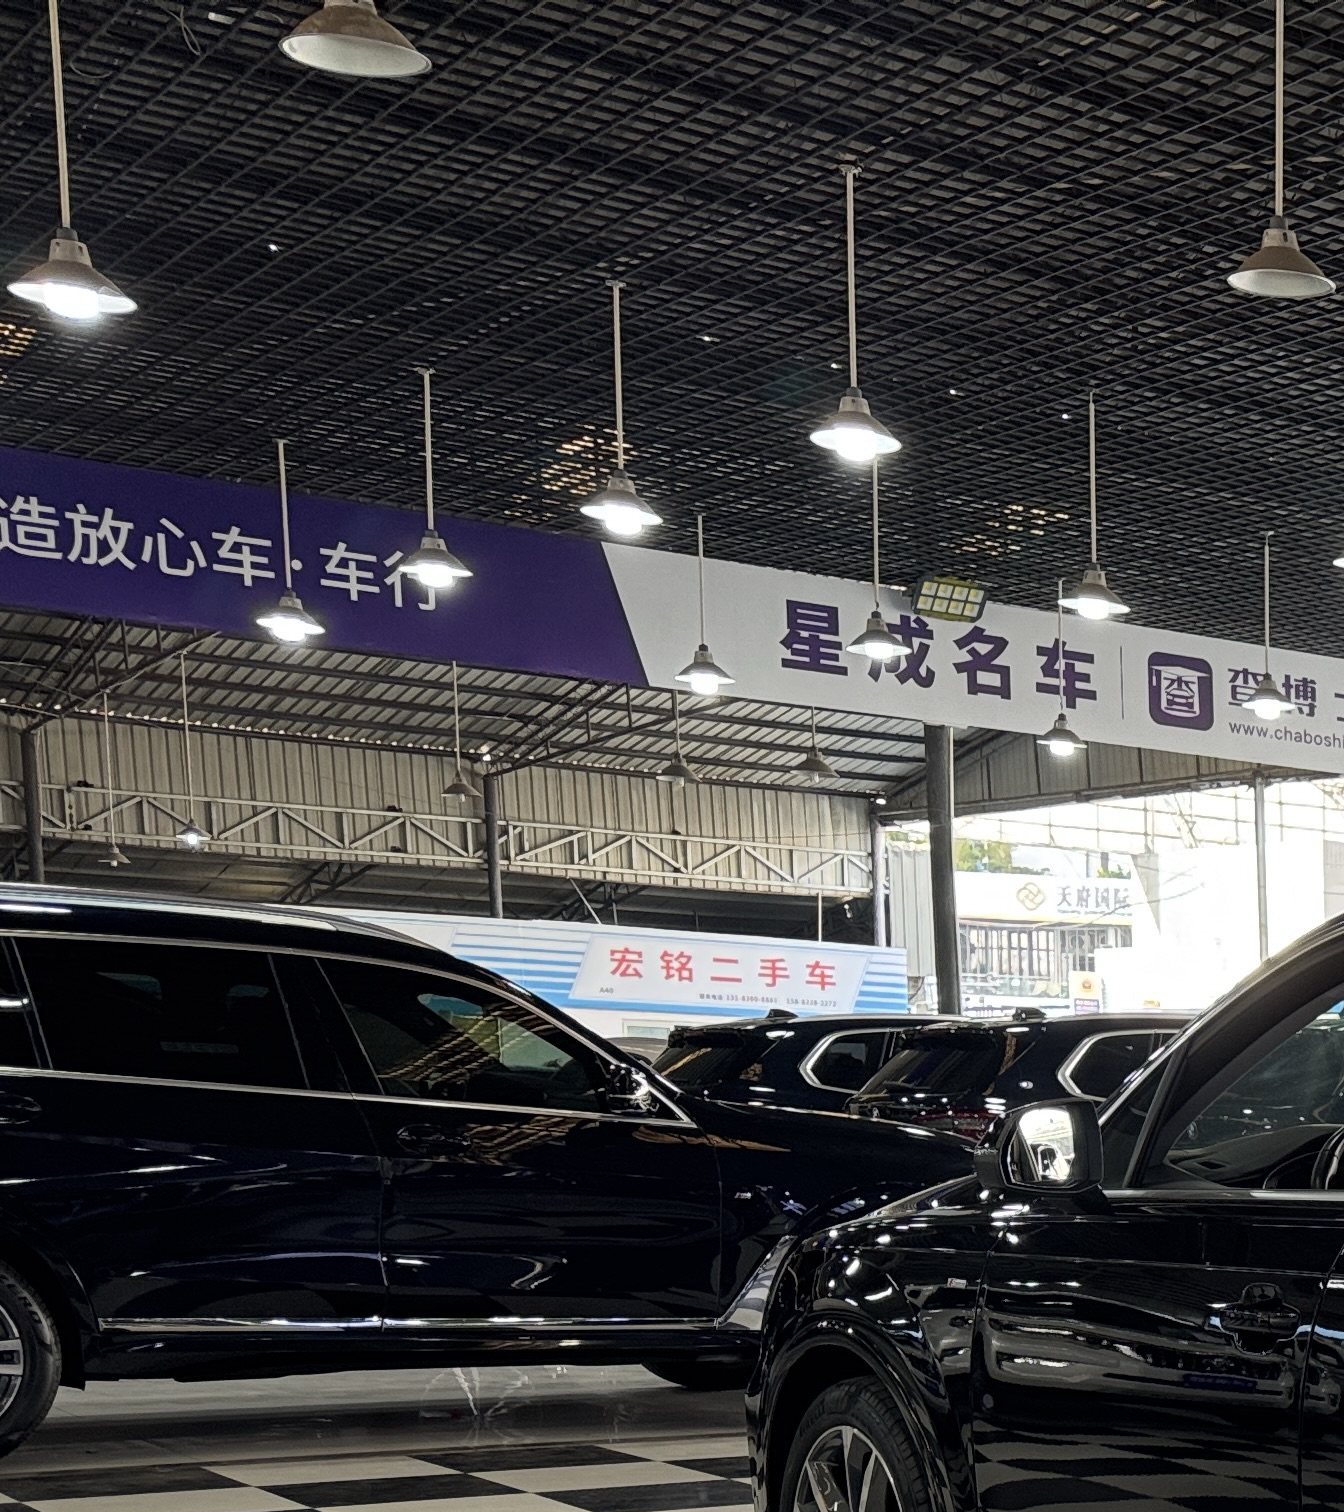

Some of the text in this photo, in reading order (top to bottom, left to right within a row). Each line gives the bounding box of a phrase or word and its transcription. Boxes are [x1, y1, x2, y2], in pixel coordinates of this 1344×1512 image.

[780, 599, 1098, 709] 星成名车
[610, 947, 837, 991] 宏铭二手车
